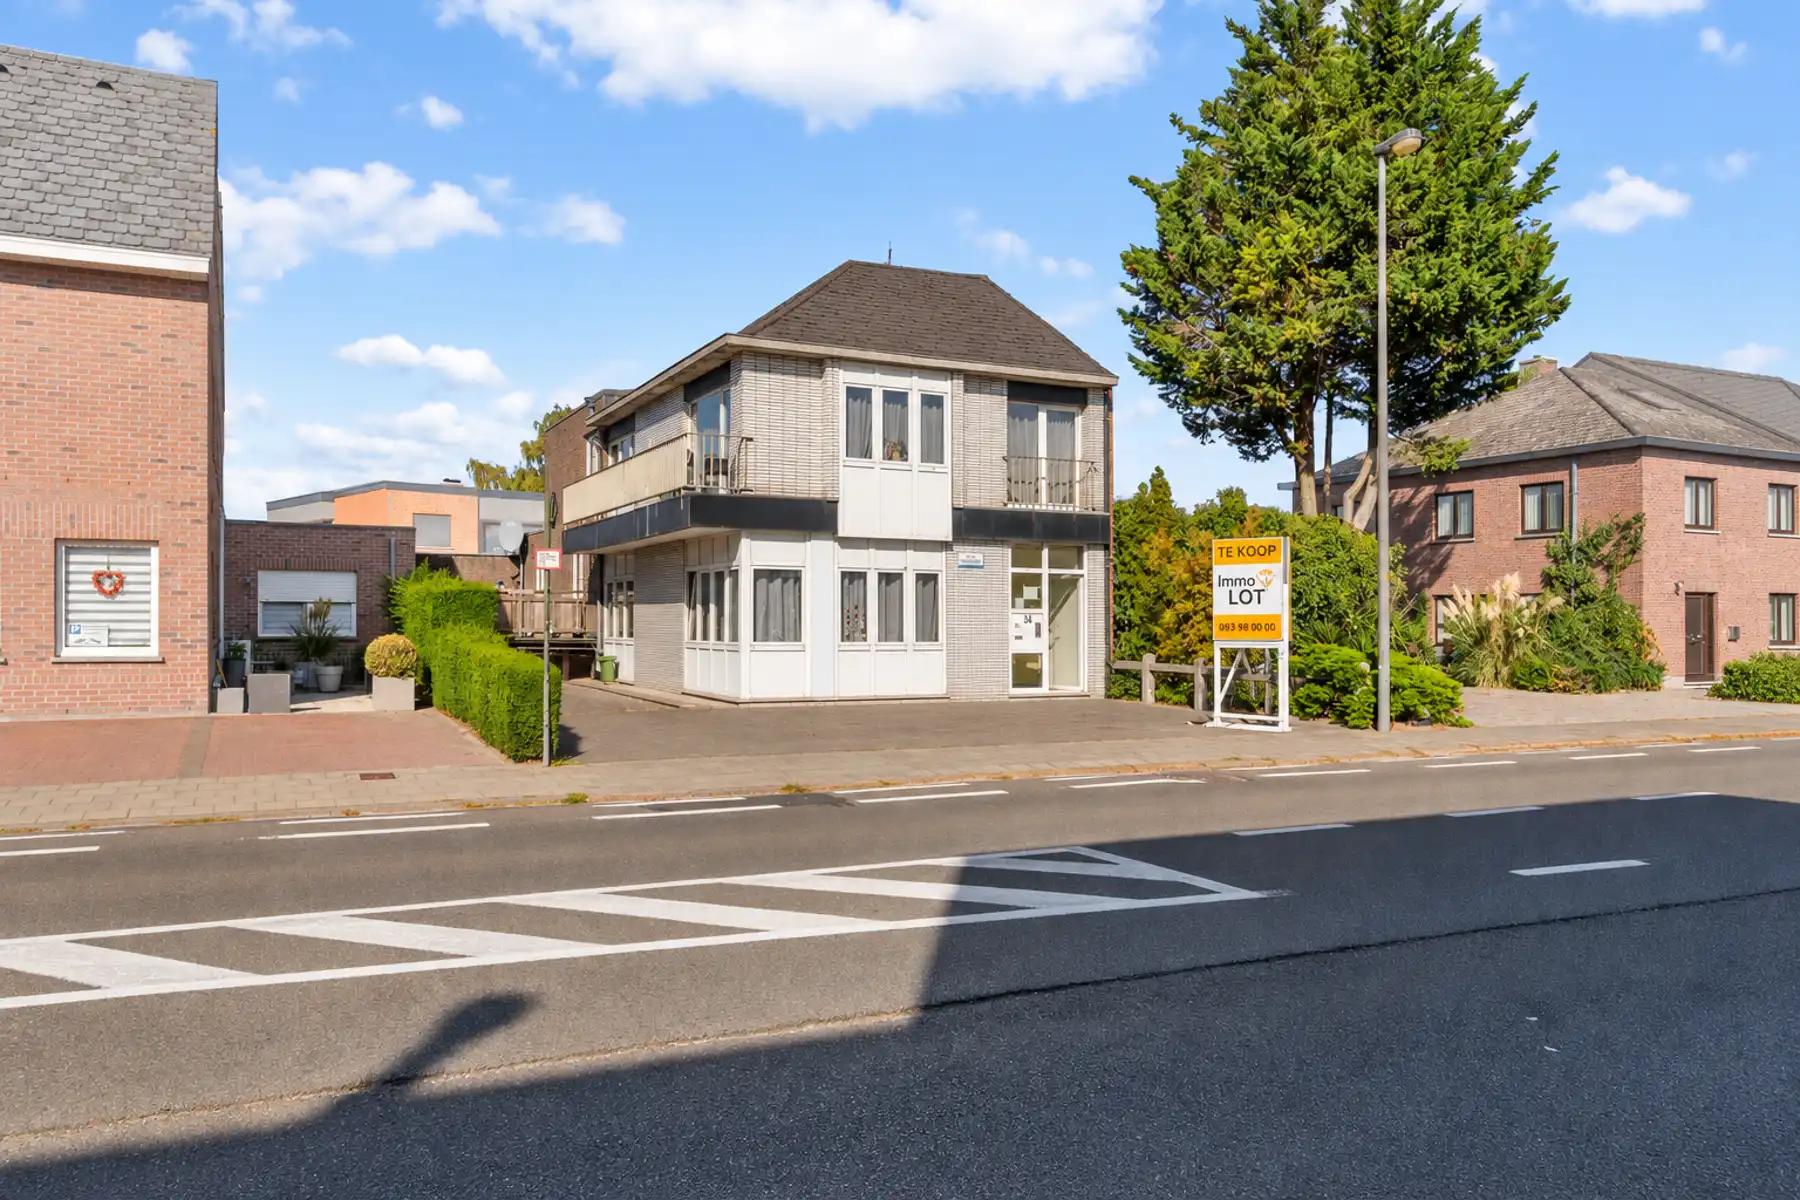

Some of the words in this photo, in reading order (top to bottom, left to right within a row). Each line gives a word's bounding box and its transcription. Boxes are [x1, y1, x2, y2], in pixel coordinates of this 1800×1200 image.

[1218, 546, 1233, 557] TE
[1237, 545, 1276, 557] KOOP
[1218, 575, 1255, 587] Immo
[1229, 589, 1265, 605] LOT
[1219, 623, 1236, 632] 093
[1251, 623, 1262, 632] 00
[1264, 622, 1276, 632] 00
